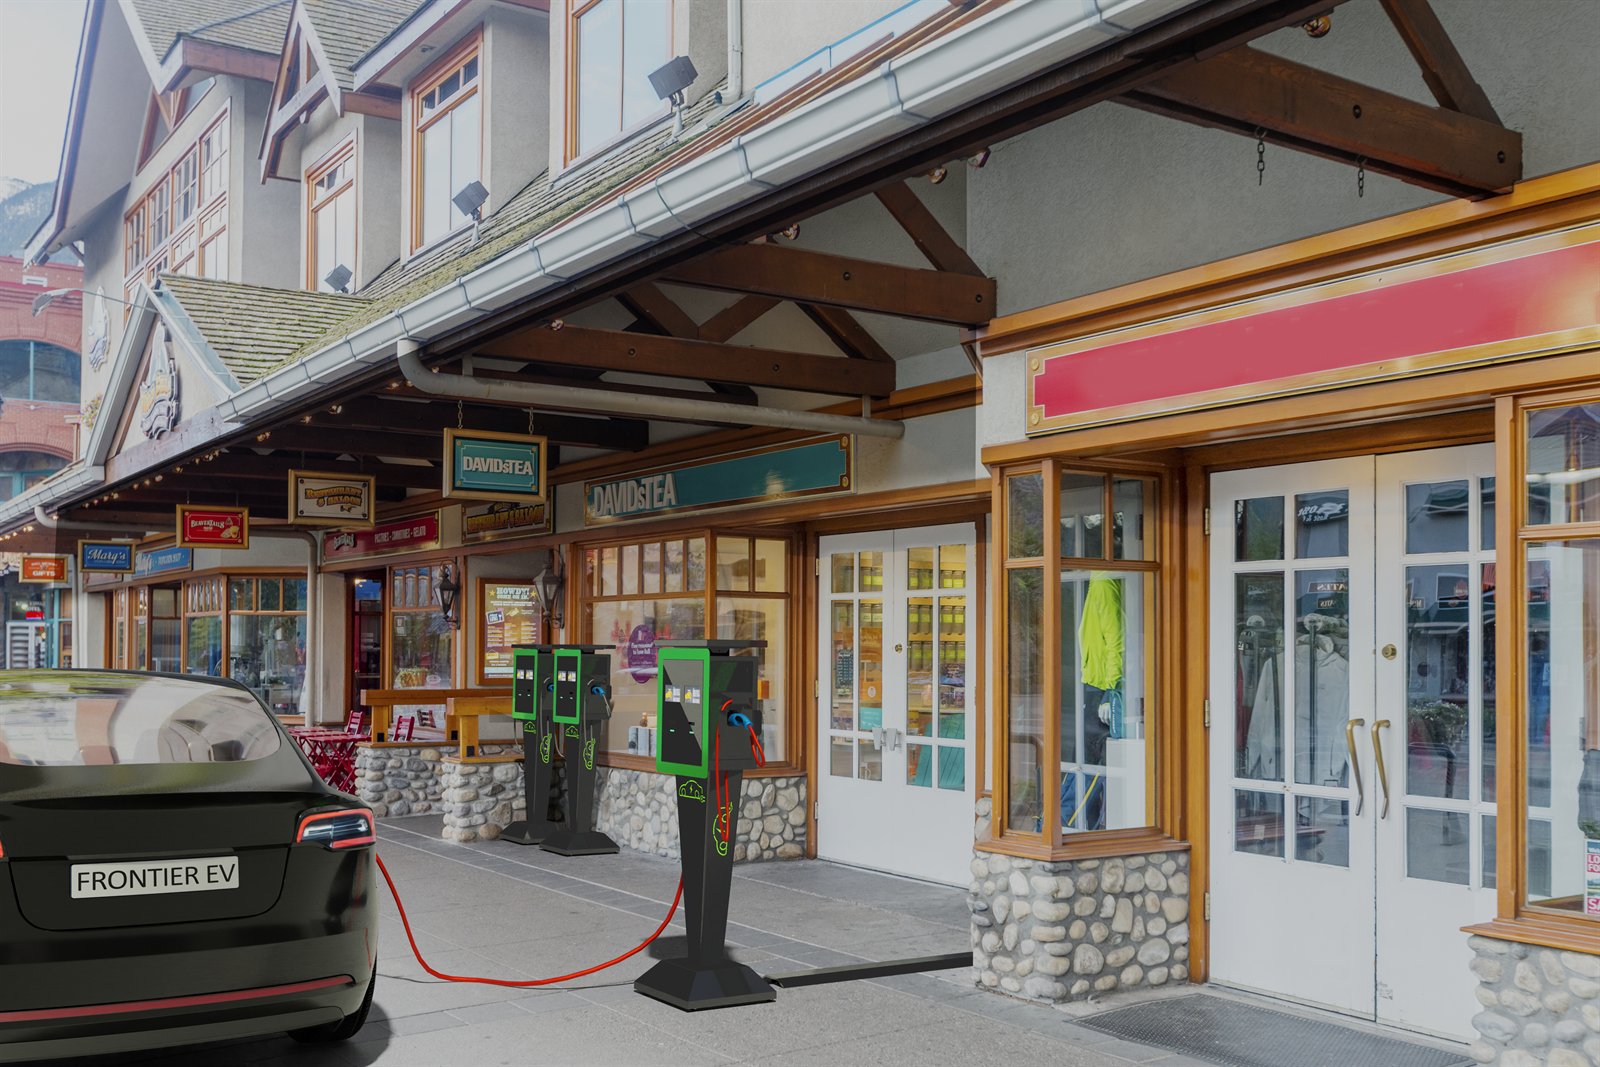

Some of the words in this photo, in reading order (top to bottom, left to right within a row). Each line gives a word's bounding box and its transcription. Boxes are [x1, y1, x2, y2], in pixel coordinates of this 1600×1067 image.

[87, 549, 126, 565] Mary's
[78, 866, 200, 891] FRONTIER
[207, 864, 235, 884] EV
